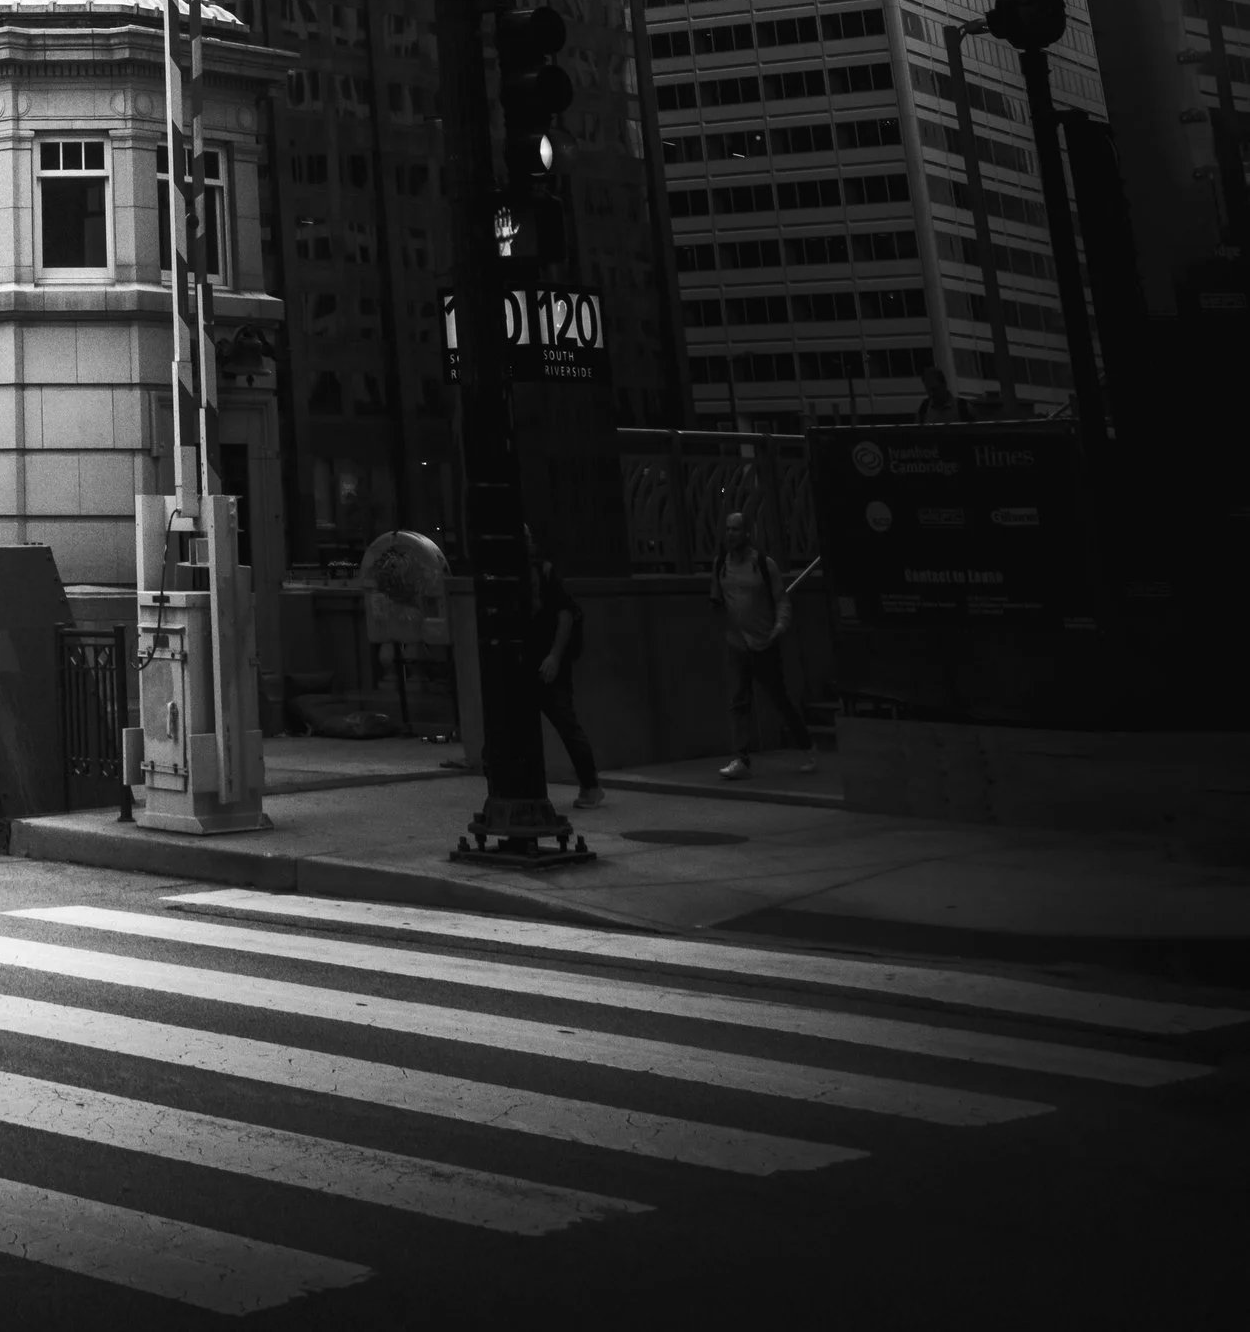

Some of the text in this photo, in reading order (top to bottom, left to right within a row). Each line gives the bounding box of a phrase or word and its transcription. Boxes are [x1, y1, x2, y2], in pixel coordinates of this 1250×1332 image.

[537, 290, 598, 349] 120
[543, 349, 575, 362] SOUTH
[544, 364, 594, 378] RIVERSIDE
[972, 445, 1035, 468] Hines
[890, 459, 960, 476] Cambridge
[904, 566, 951, 584] Contact
